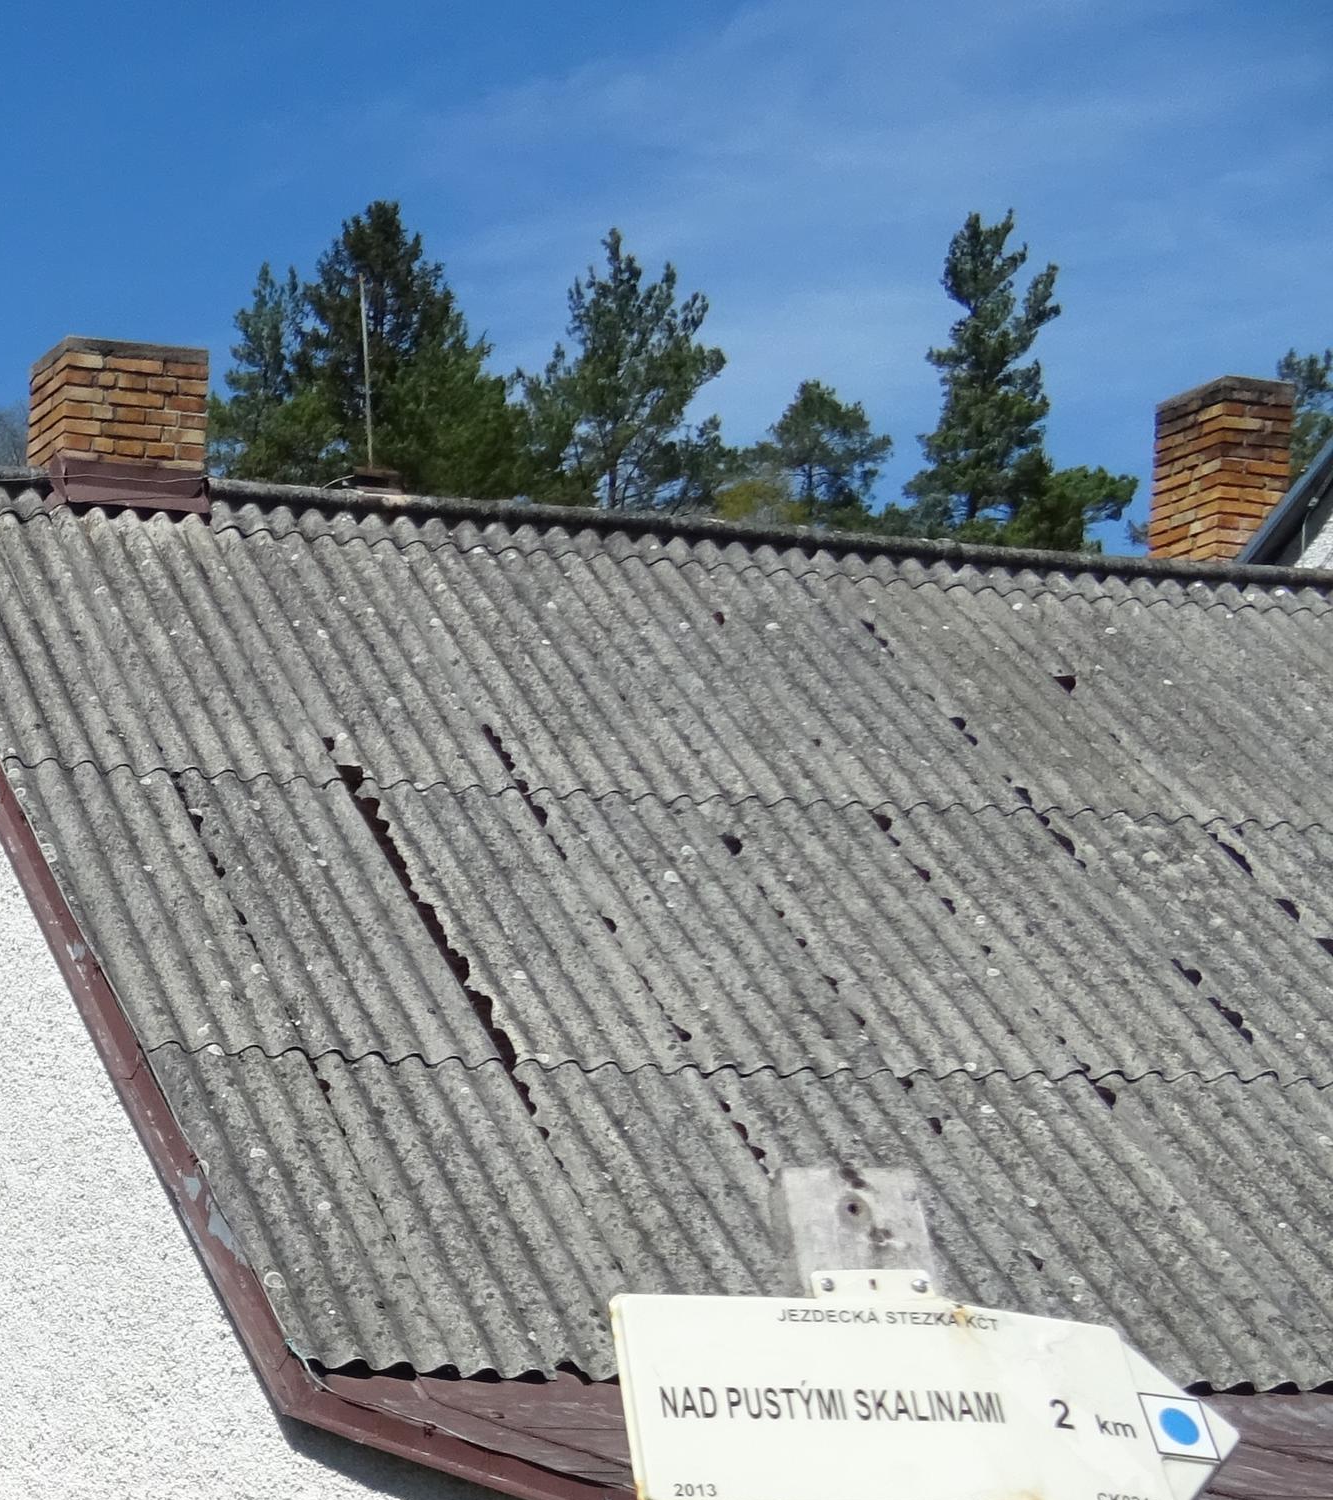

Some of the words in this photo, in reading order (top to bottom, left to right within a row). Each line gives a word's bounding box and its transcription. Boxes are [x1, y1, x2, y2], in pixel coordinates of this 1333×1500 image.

[777, 1307, 880, 1324] JEZDECKÁ
[885, 1311, 957, 1326] STEZKA
[965, 1313, 998, 1331] KČT
[659, 1385, 717, 1419] NAD
[726, 1380, 848, 1420] PUSTÝMI
[854, 1389, 1006, 1423] SKALINAMI
[1050, 1399, 1075, 1430] 2
[1095, 1414, 1137, 1439] km
[673, 1482, 717, 1498] 2013
